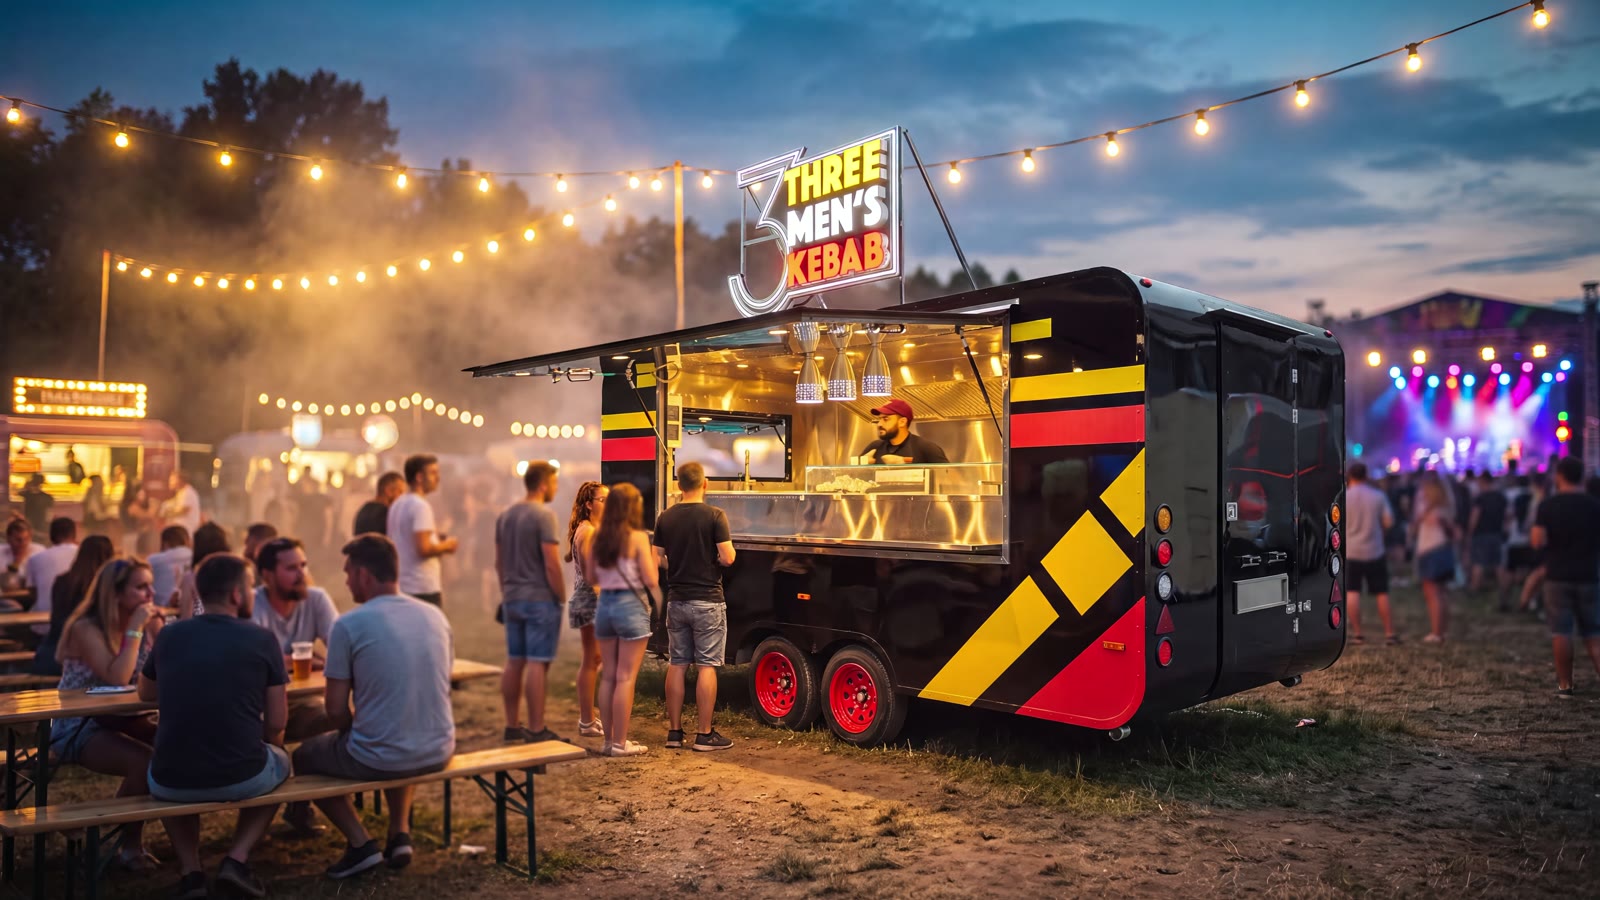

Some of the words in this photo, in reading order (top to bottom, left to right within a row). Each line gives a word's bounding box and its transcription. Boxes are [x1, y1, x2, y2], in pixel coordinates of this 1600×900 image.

[784, 138, 884, 207] THREE
[728, 147, 806, 317] 3
[786, 184, 886, 247] MEN'S
[786, 231, 888, 288] KEBAB
